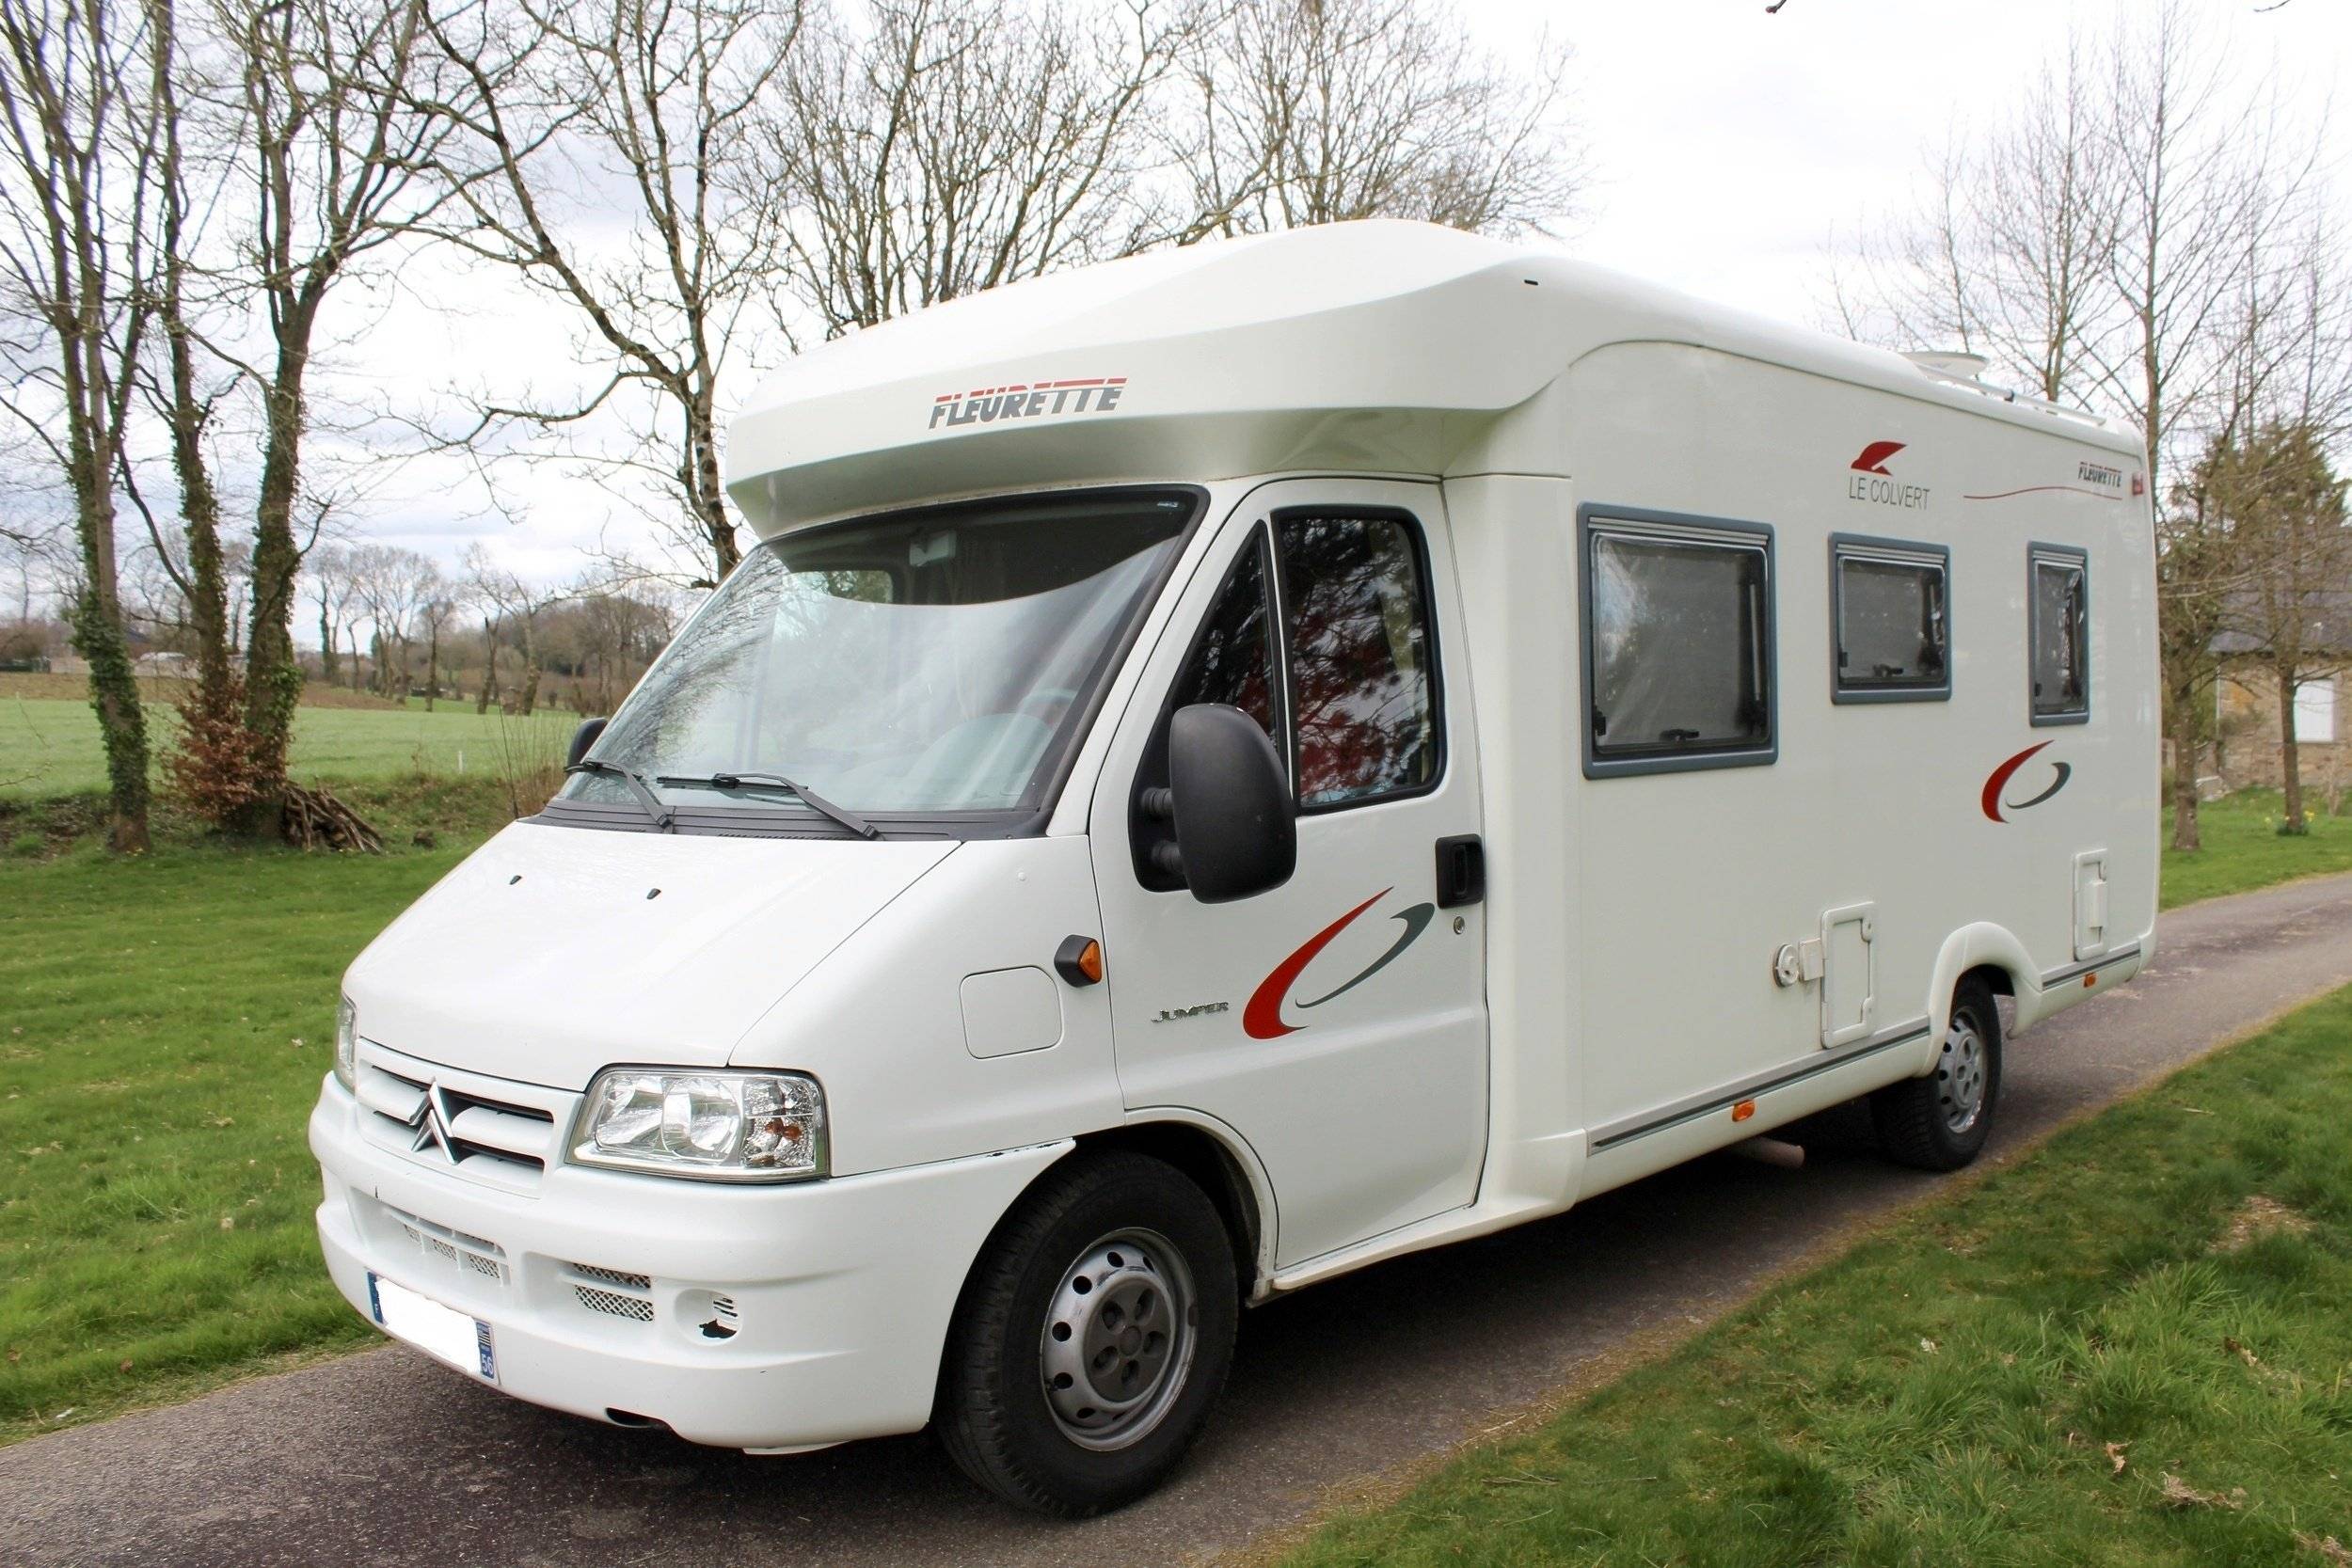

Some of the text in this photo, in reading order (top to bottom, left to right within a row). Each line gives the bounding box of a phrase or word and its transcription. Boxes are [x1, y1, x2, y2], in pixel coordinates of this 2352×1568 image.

[929, 377, 1128, 430] FLEURETTE
[2077, 461, 2122, 488] FLEURETTE
[1849, 476, 1931, 511] LE COLVERT
[1151, 1002, 1229, 1023] JUMPER
[481, 1353, 494, 1374] 56
